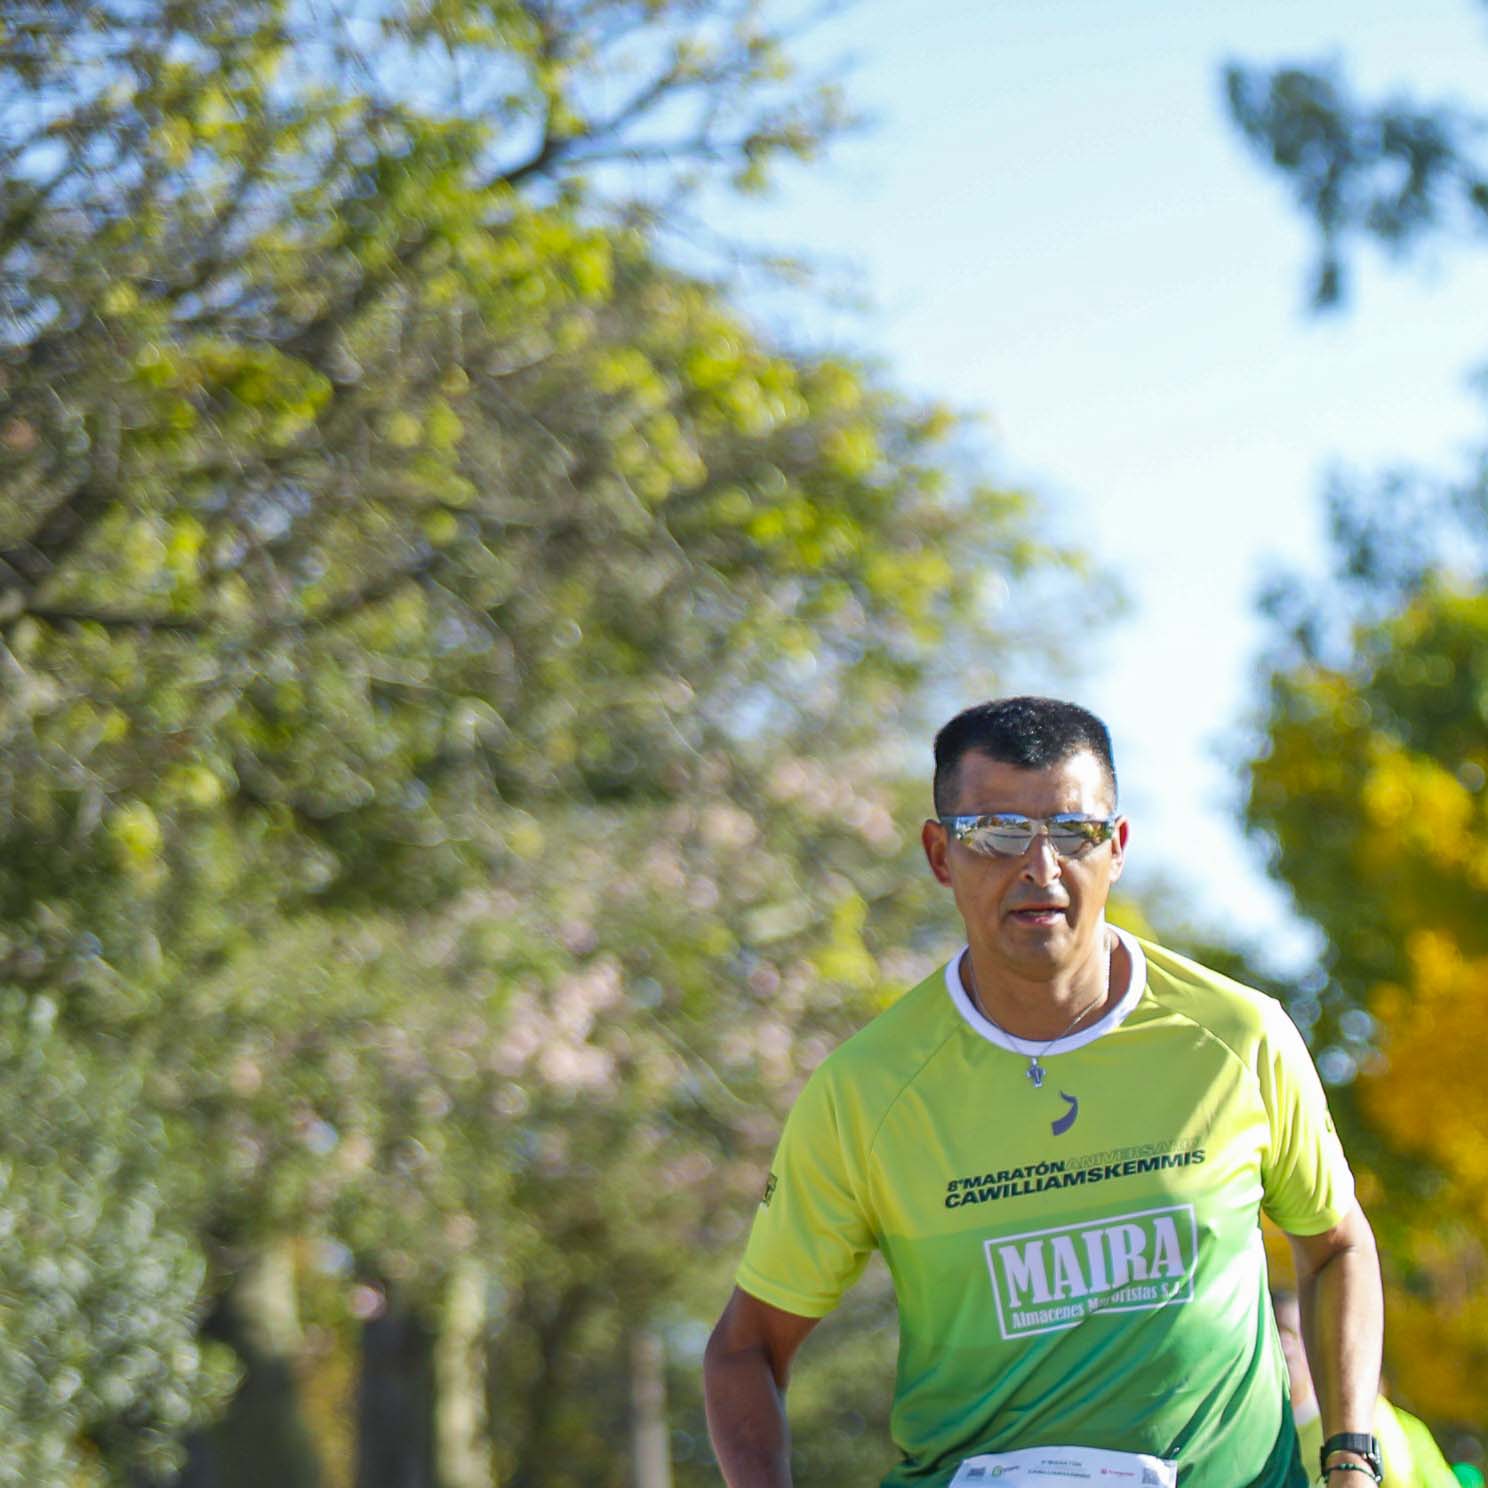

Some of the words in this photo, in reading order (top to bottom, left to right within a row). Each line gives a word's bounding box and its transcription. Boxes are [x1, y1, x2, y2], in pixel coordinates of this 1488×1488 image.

[945, 1150, 1206, 1208] CAWILLIAMSKEMMIS
[998, 1216, 1185, 1308] MAIRA
[1012, 1303, 1085, 1329] Almacenes
